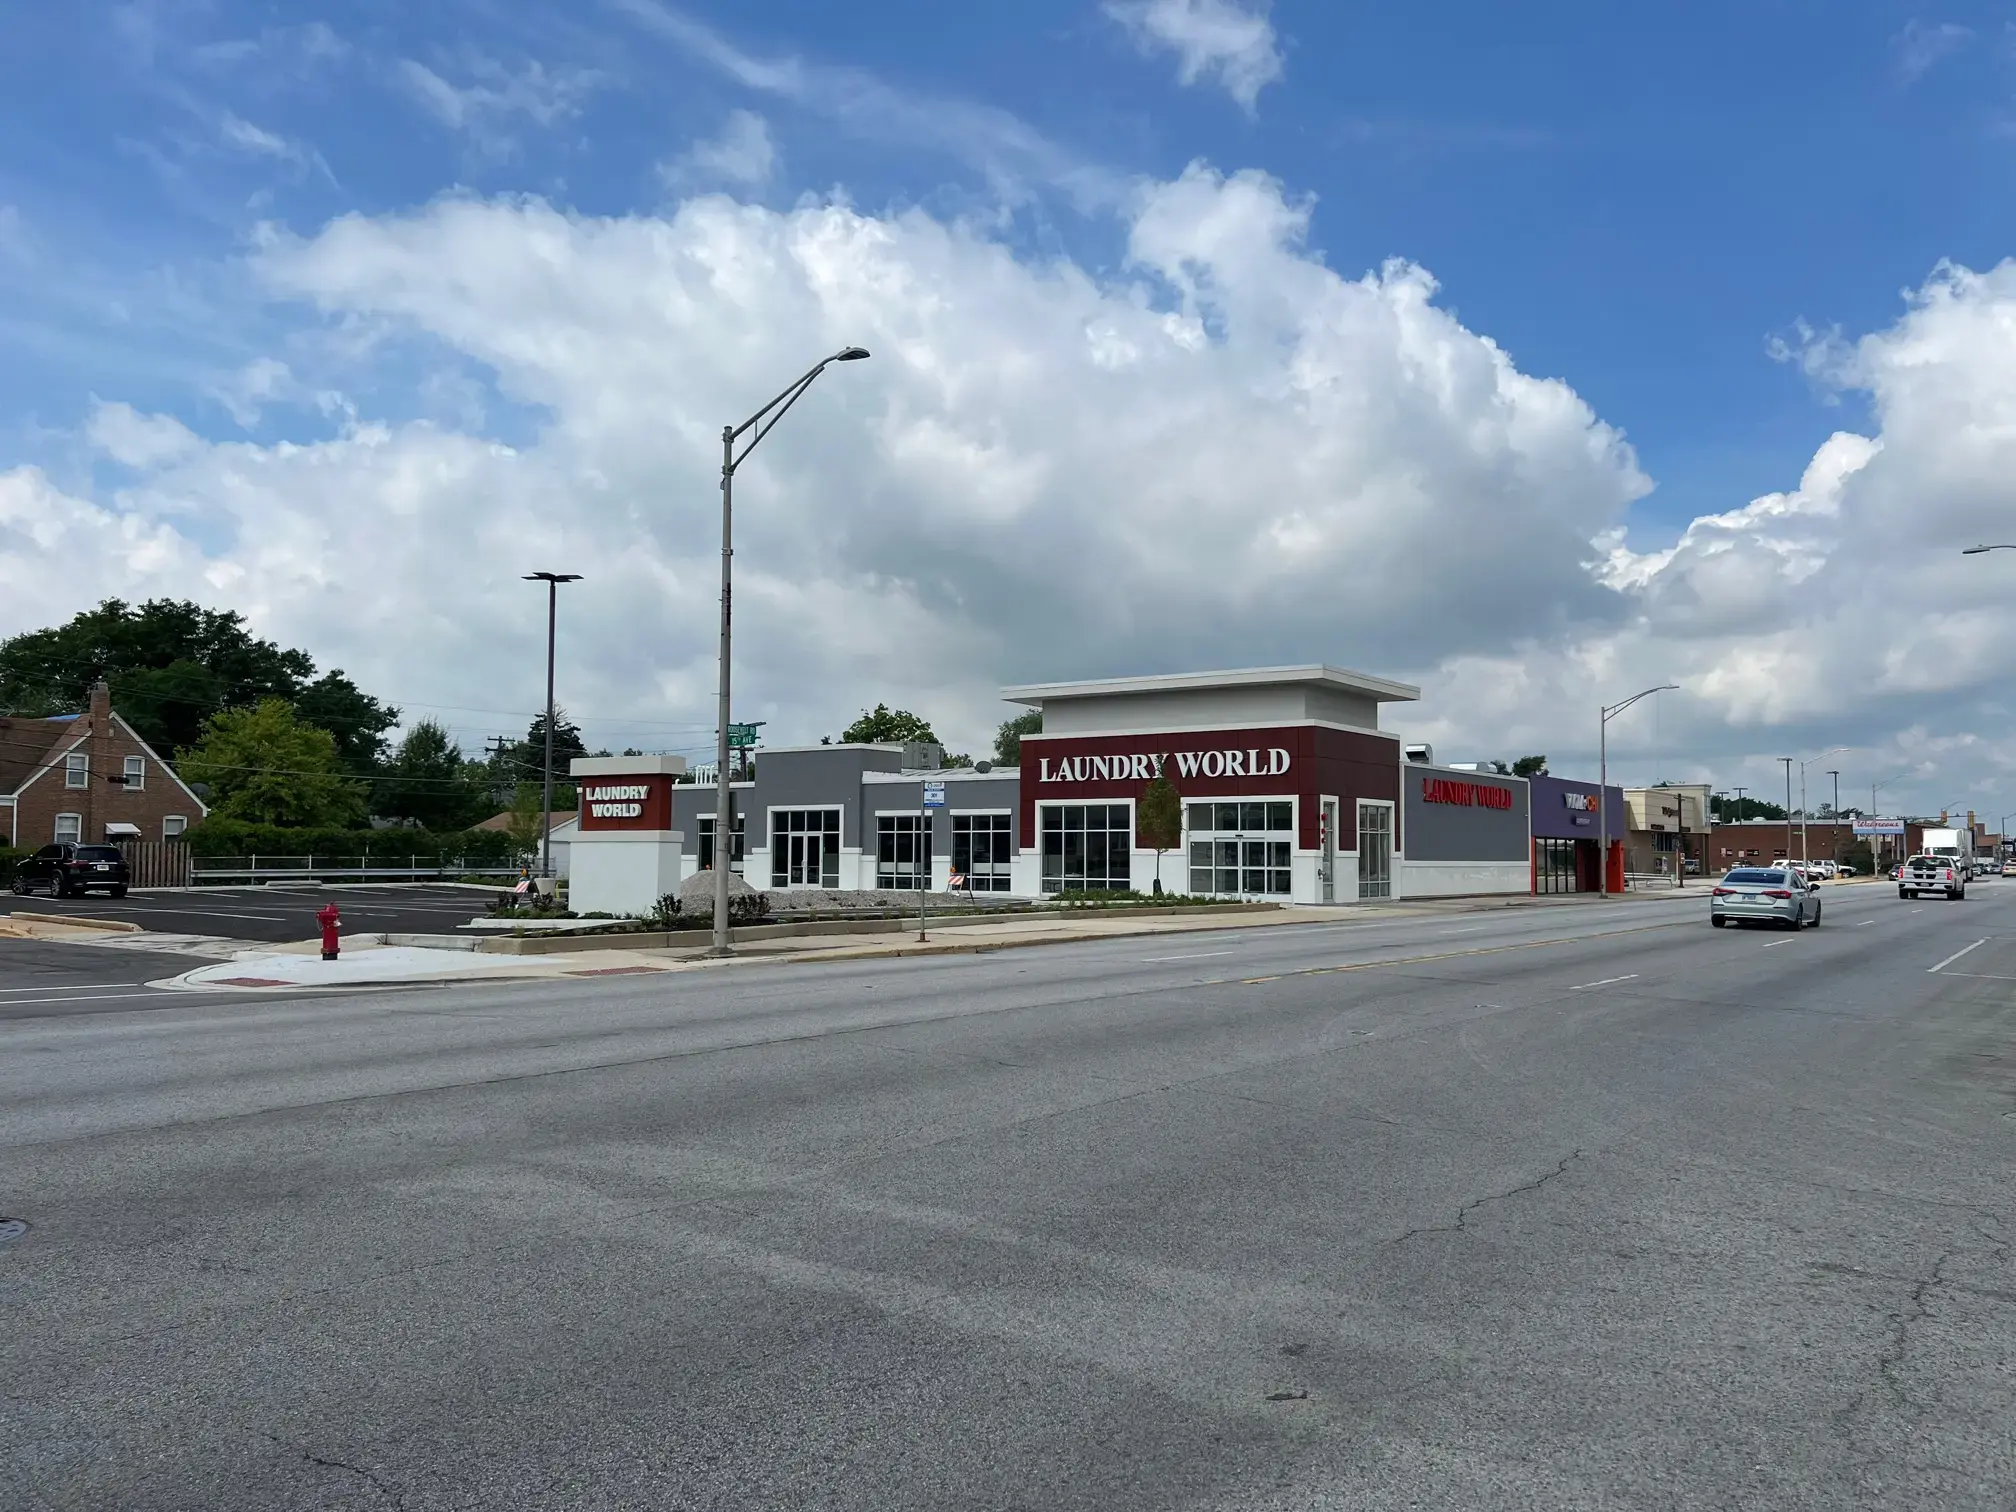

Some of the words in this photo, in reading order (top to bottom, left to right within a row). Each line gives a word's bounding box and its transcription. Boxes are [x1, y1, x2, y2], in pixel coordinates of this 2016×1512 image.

[742, 735, 752, 743] AVE
[1039, 753, 1169, 782] LAUNDRY
[1174, 748, 1291, 778] WORLD
[585, 785, 650, 801] LAUNDRY
[1423, 778, 1475, 806] LAUNDRY
[1475, 785, 1513, 810] WORLD
[591, 803, 642, 818] WORLD
